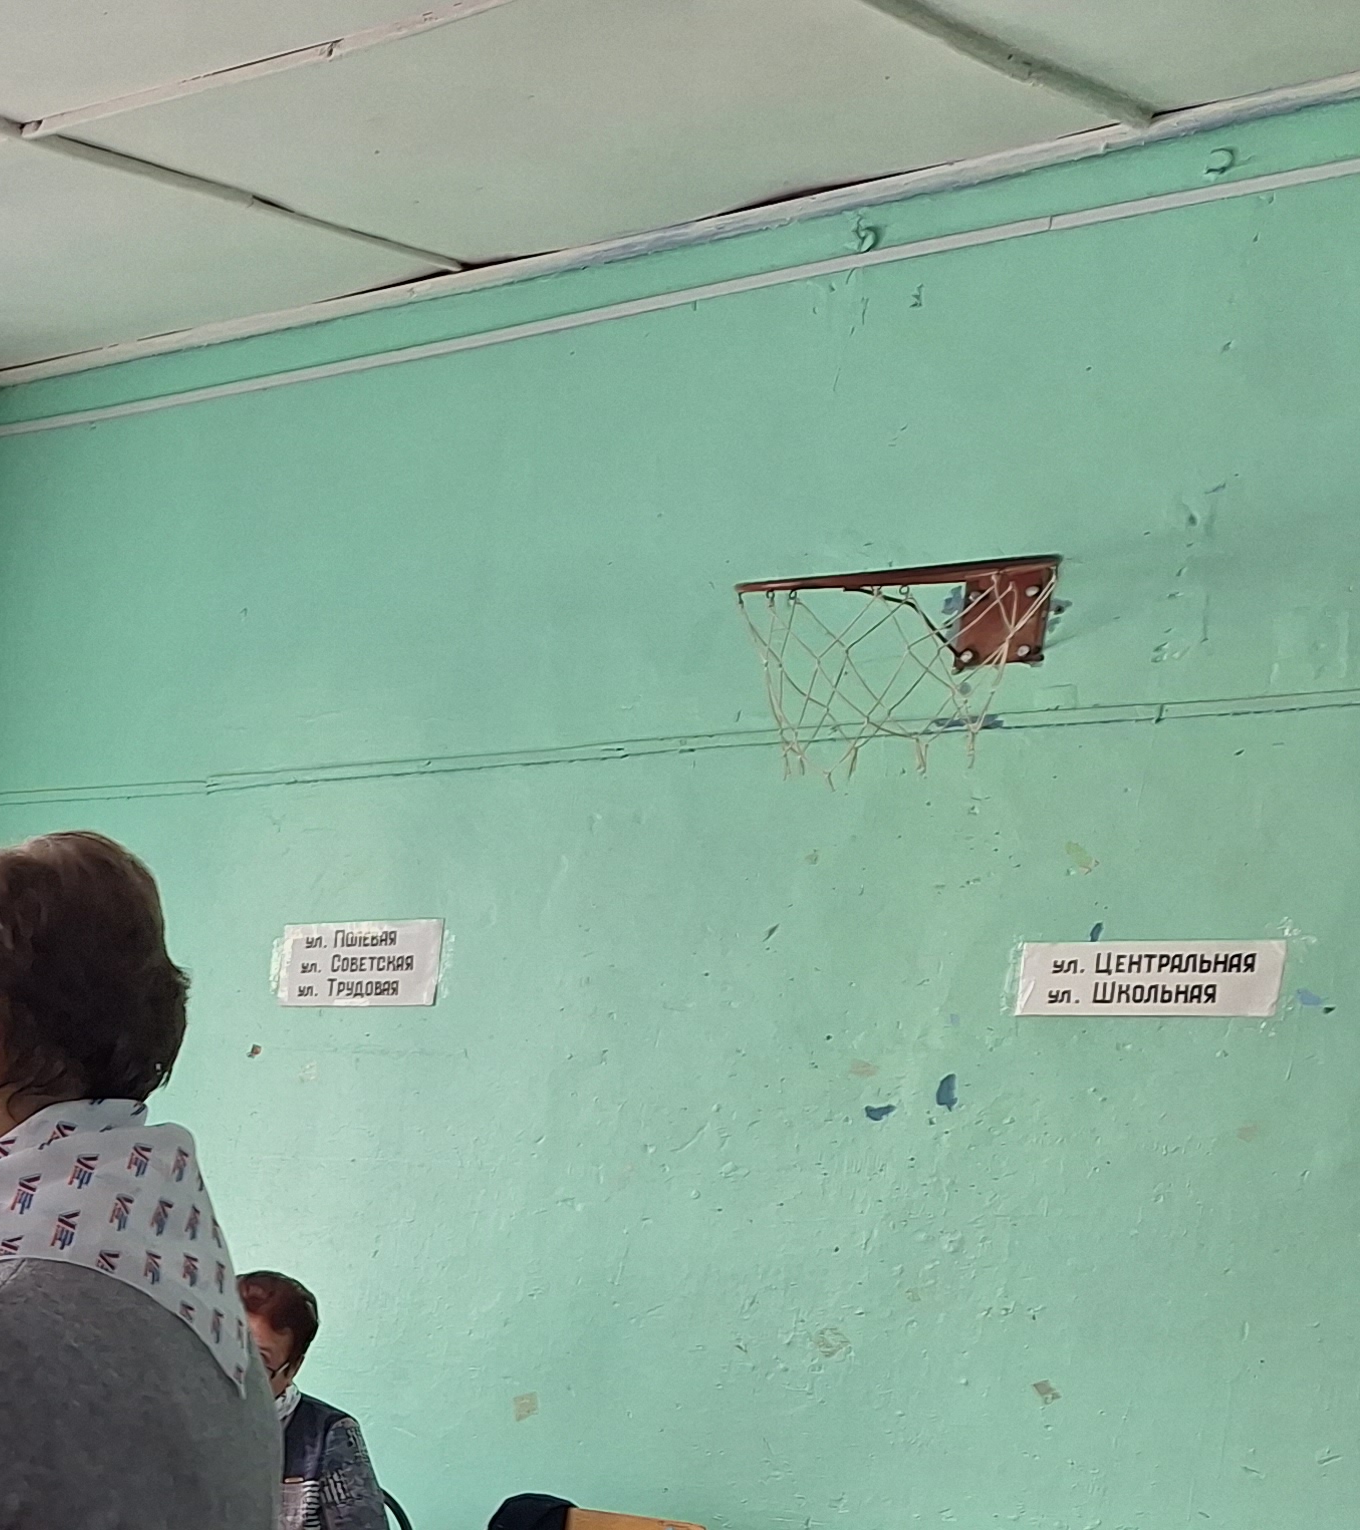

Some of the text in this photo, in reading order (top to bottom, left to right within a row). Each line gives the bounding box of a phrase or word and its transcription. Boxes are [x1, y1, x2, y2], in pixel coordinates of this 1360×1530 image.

[305, 936, 327, 949] ул.
[300, 962, 321, 974] ул.
[1051, 952, 1257, 976] ул. ЦЕНТРАЛЬНАЯ
[297, 985, 318, 997] ул.
[1047, 981, 1217, 1005] ул. ШКОЛЬНАЯ
